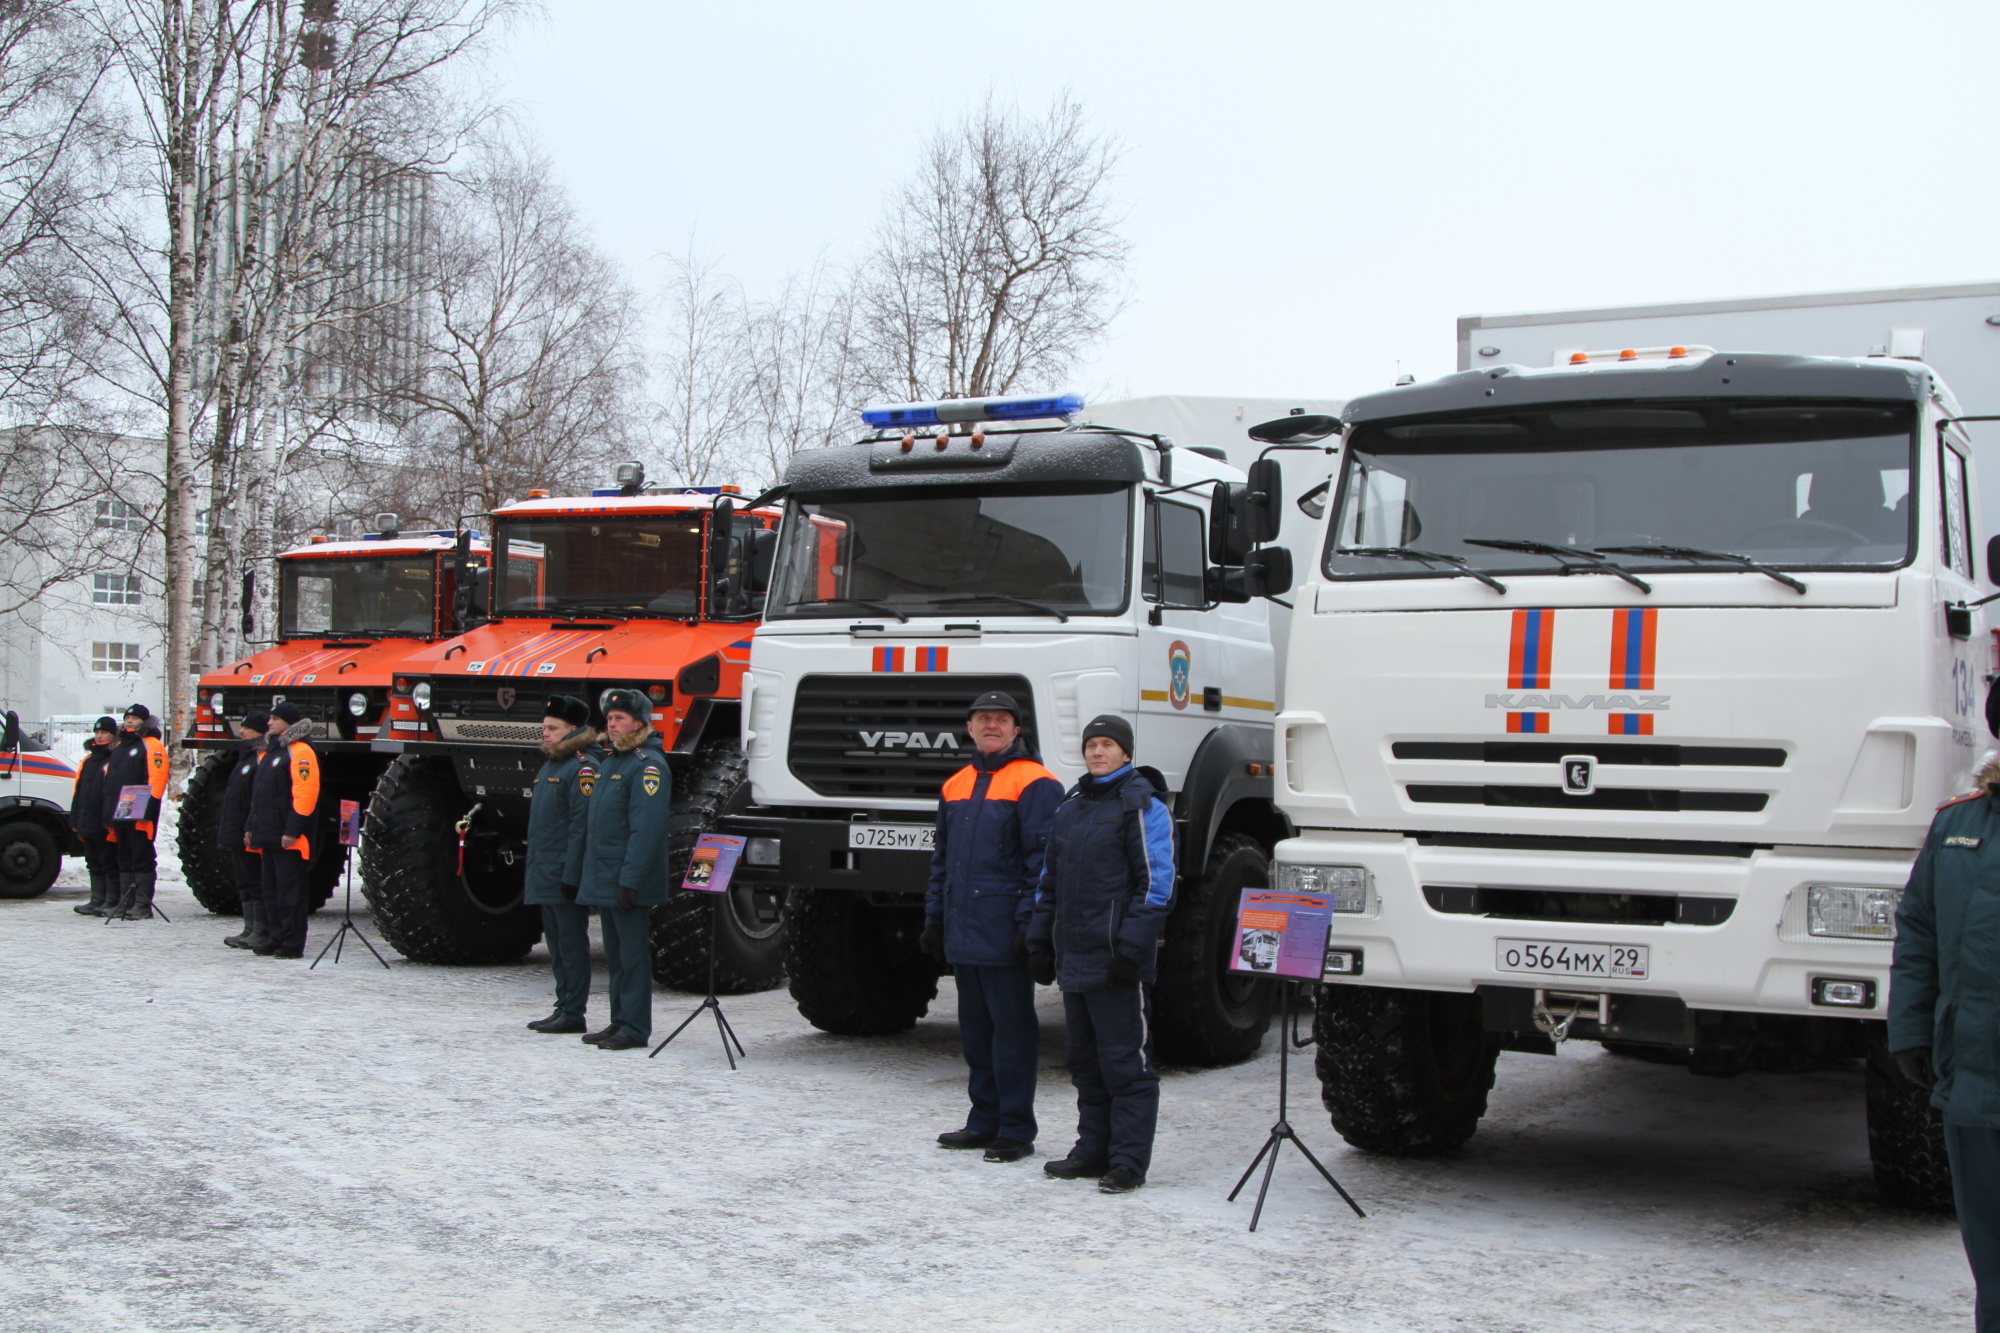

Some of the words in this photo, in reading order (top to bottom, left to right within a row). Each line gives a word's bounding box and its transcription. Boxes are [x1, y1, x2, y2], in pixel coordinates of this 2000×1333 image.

[1953, 657, 1975, 718] 134
[1485, 694, 1670, 710] KAMAZ
[860, 731, 960, 749] УРАЛ
[1614, 948, 1639, 967] 29
[1612, 967, 1630, 975] RUS
